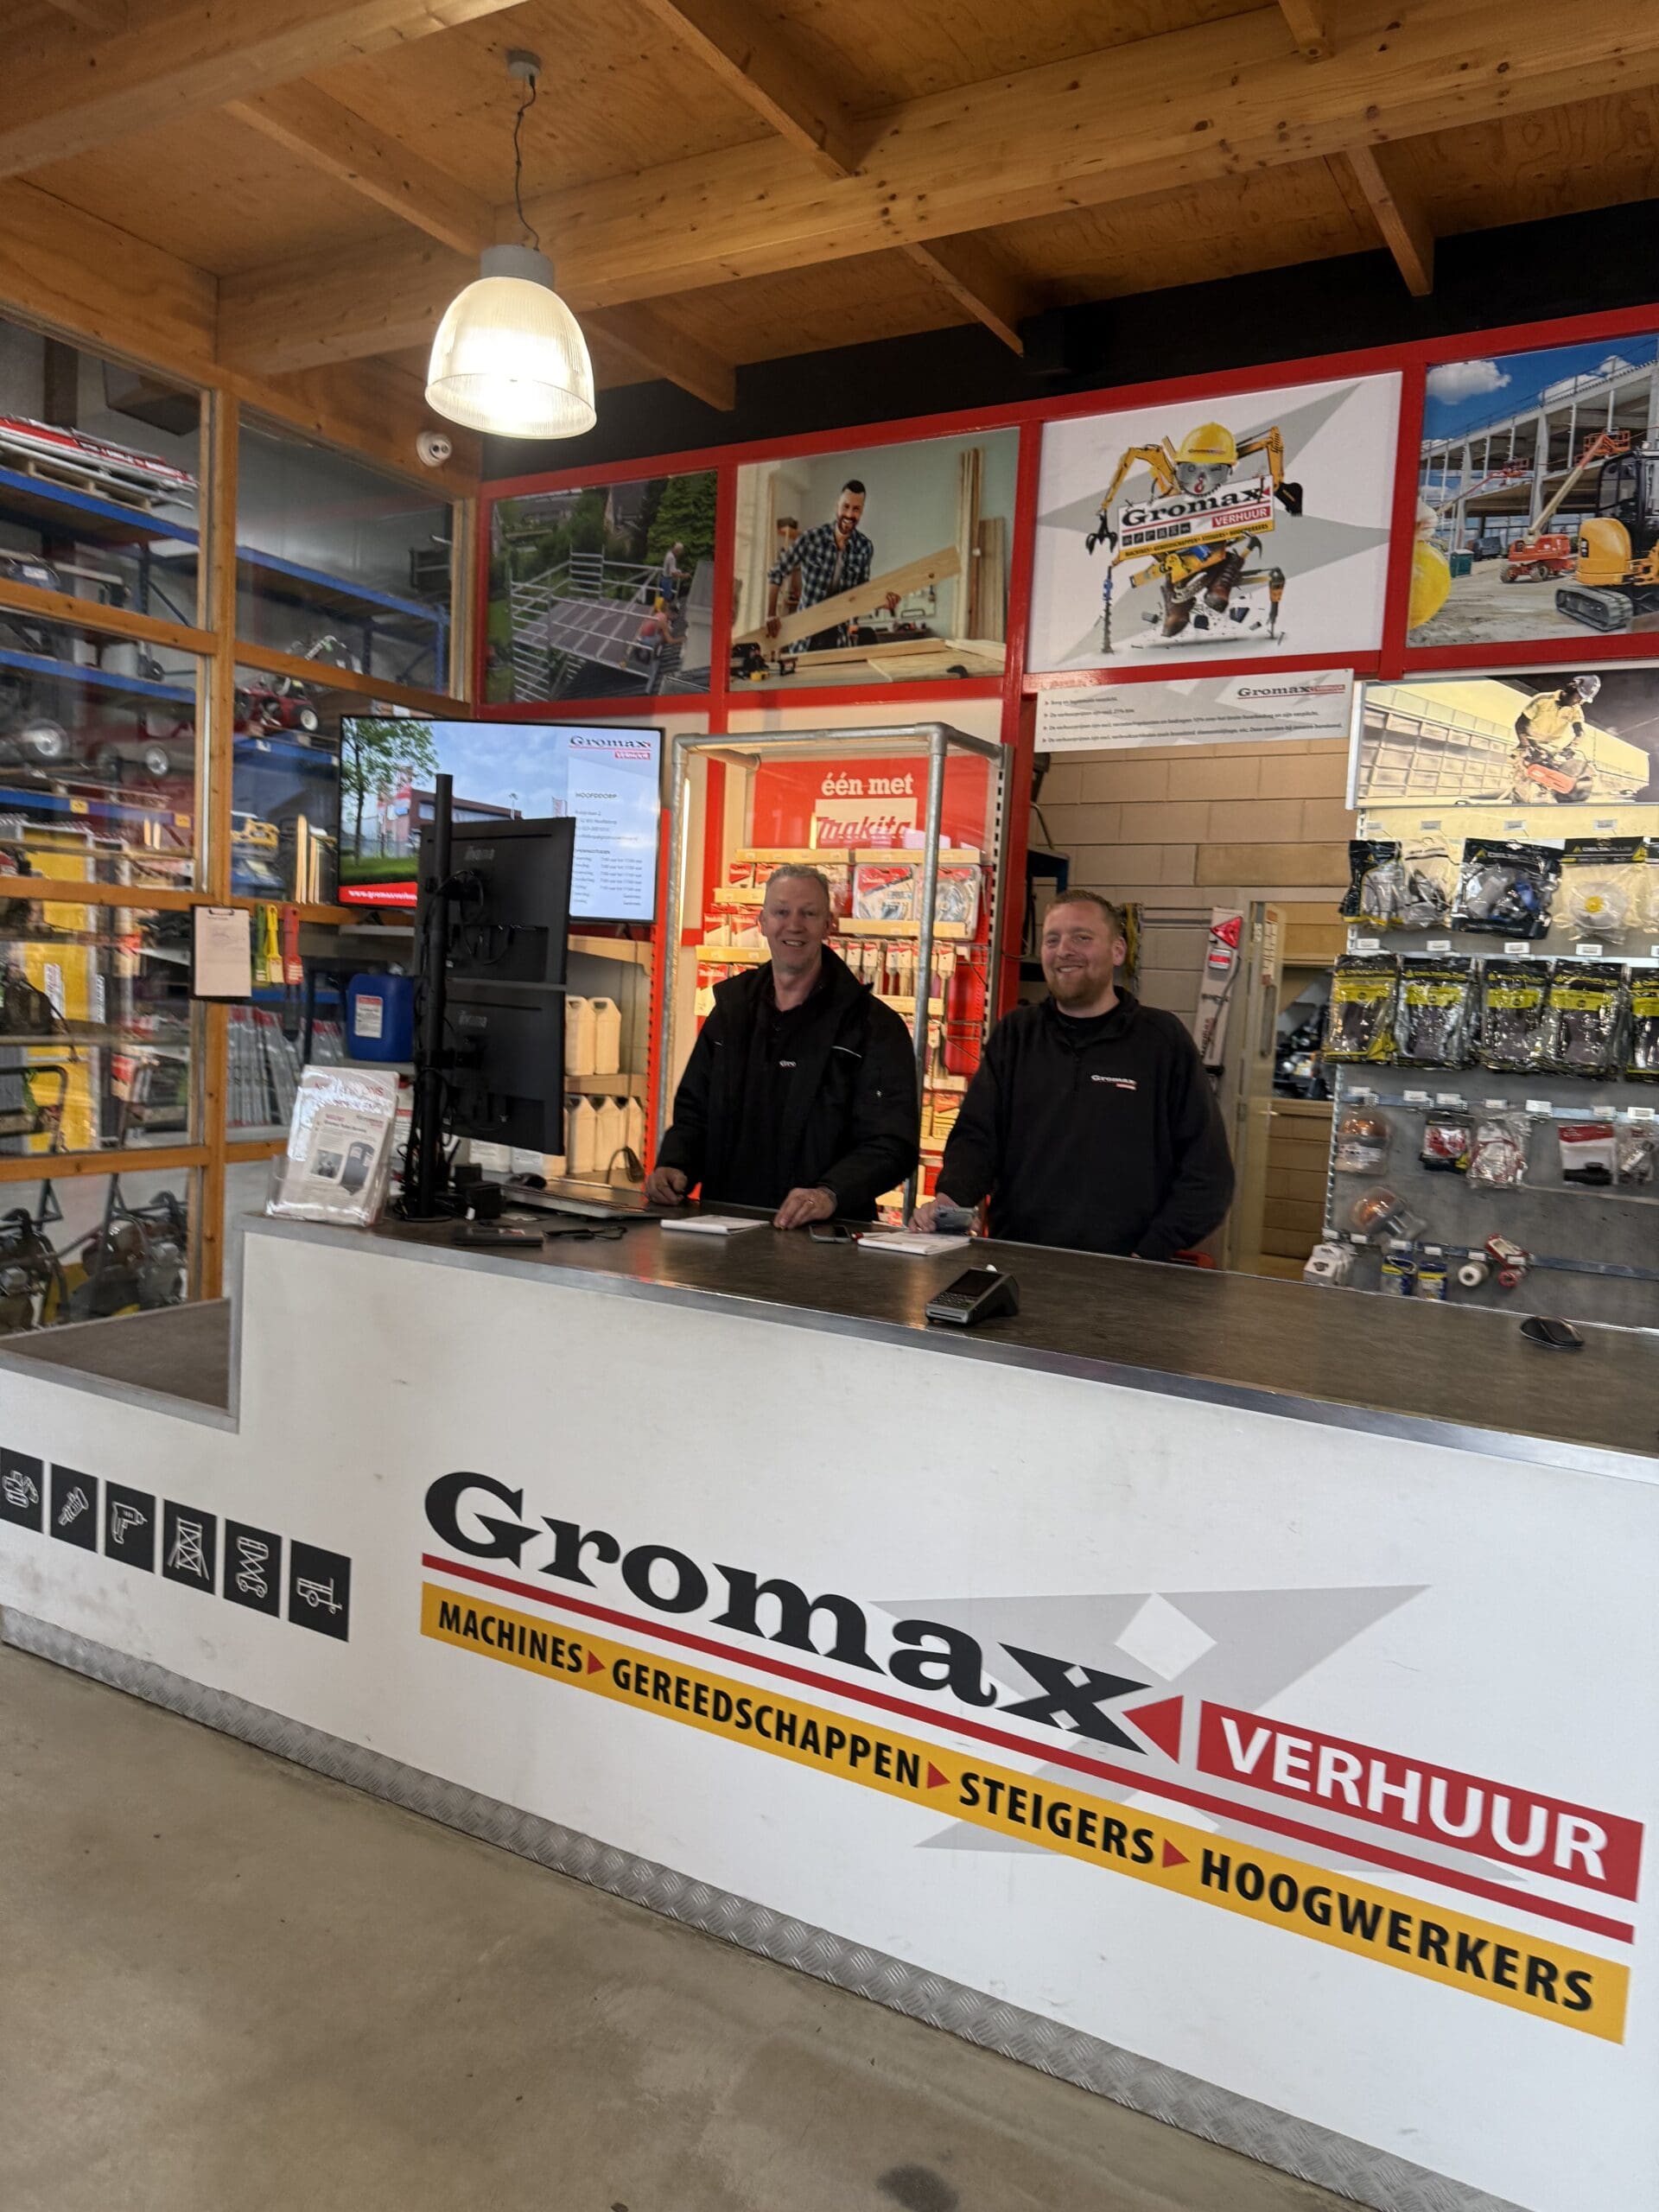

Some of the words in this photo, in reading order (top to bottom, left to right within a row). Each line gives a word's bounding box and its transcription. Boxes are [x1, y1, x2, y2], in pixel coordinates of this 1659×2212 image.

[1122, 487, 1266, 527] Gromax
[1214, 507, 1268, 526] VERHUUR
[1237, 685, 1310, 697] Gromax
[570, 735, 647, 748] Gromax
[822, 772, 864, 796] één
[868, 772, 914, 795] met
[424, 1471, 1153, 1756] Gromax
[438, 1600, 583, 1674] MACHINES
[612, 1658, 920, 1789] GEREEDSCHAPPEN
[959, 1771, 1154, 1865] STEIGERS
[1200, 1848, 1594, 2012] HOOGWERKERS
[1220, 1717, 1608, 1881] VERHUUR
